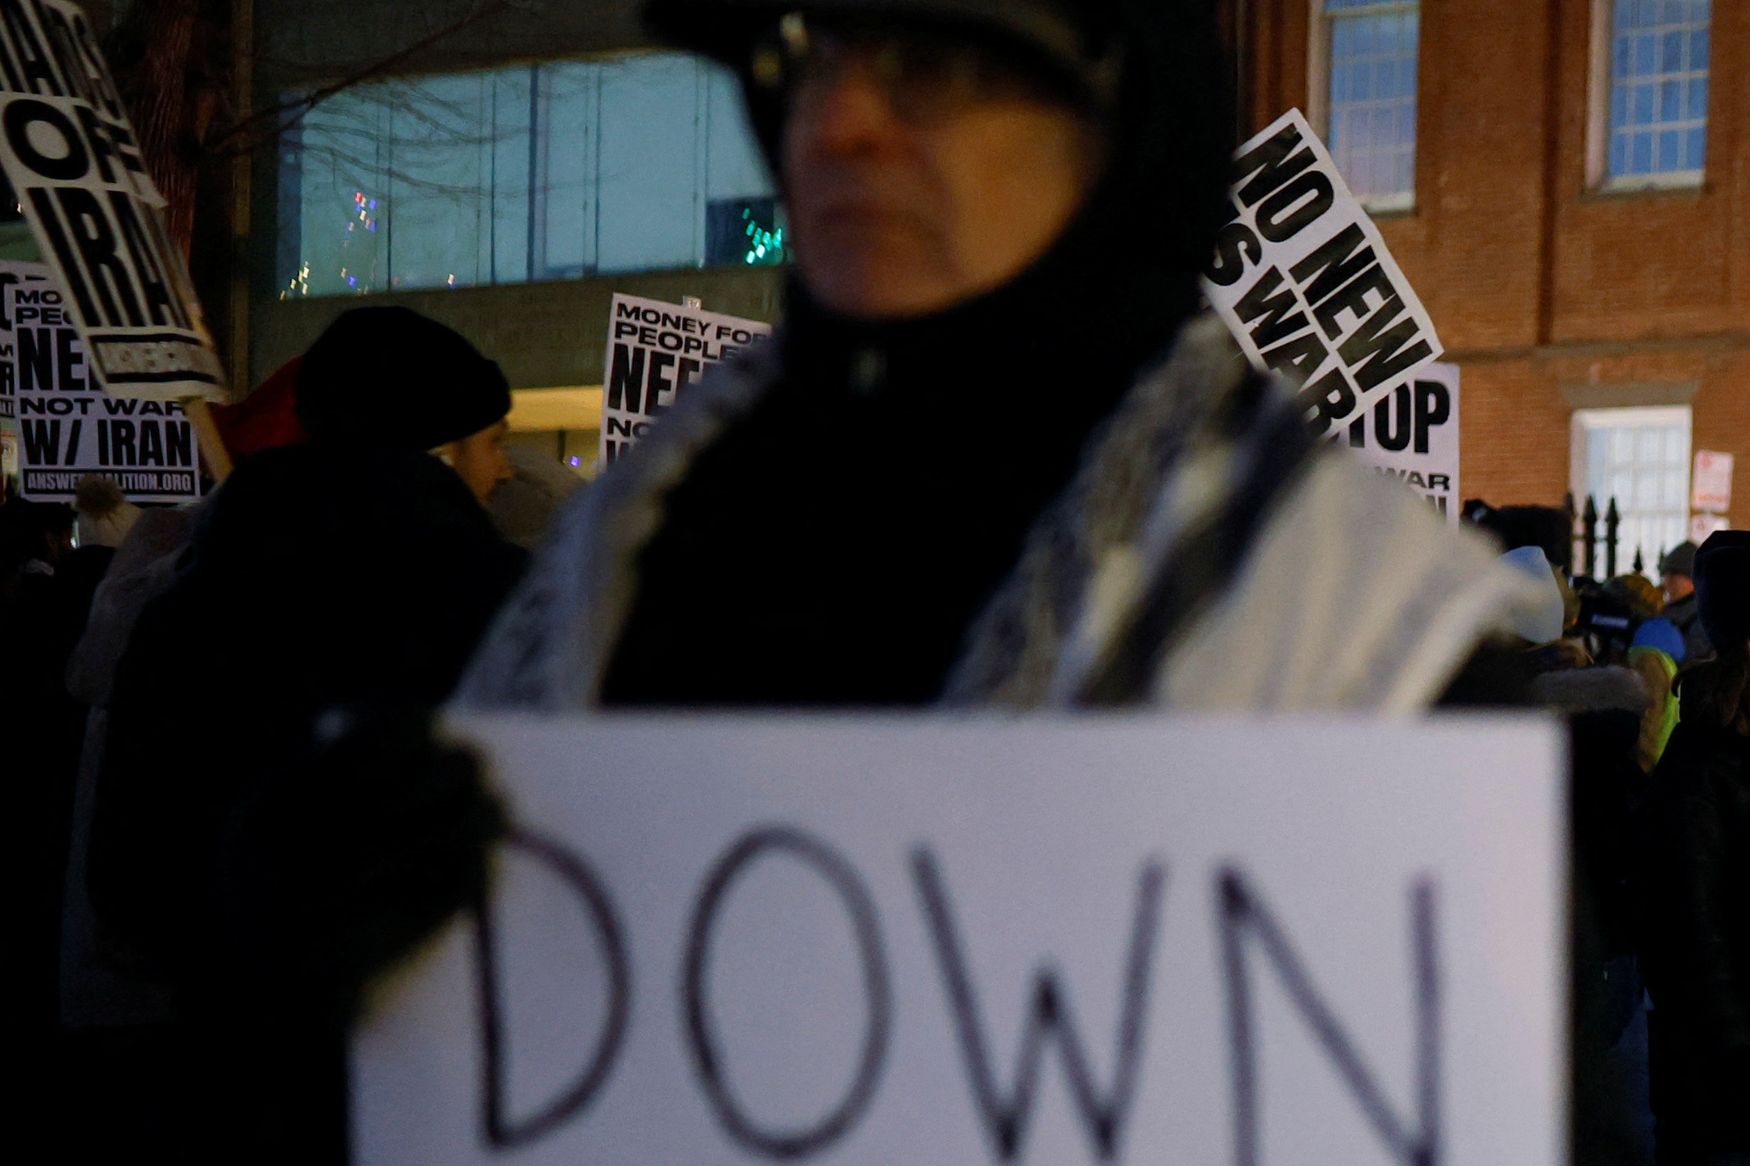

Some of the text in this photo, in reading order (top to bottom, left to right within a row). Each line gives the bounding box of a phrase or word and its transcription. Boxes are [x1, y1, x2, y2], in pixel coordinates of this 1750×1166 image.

[1231, 122, 1433, 393] NO NEW
[617, 303, 711, 335] MONEY
[615, 322, 738, 361] PEOPLE
[20, 398, 95, 415] NOT
[21, 419, 192, 466] W/ IRAN
